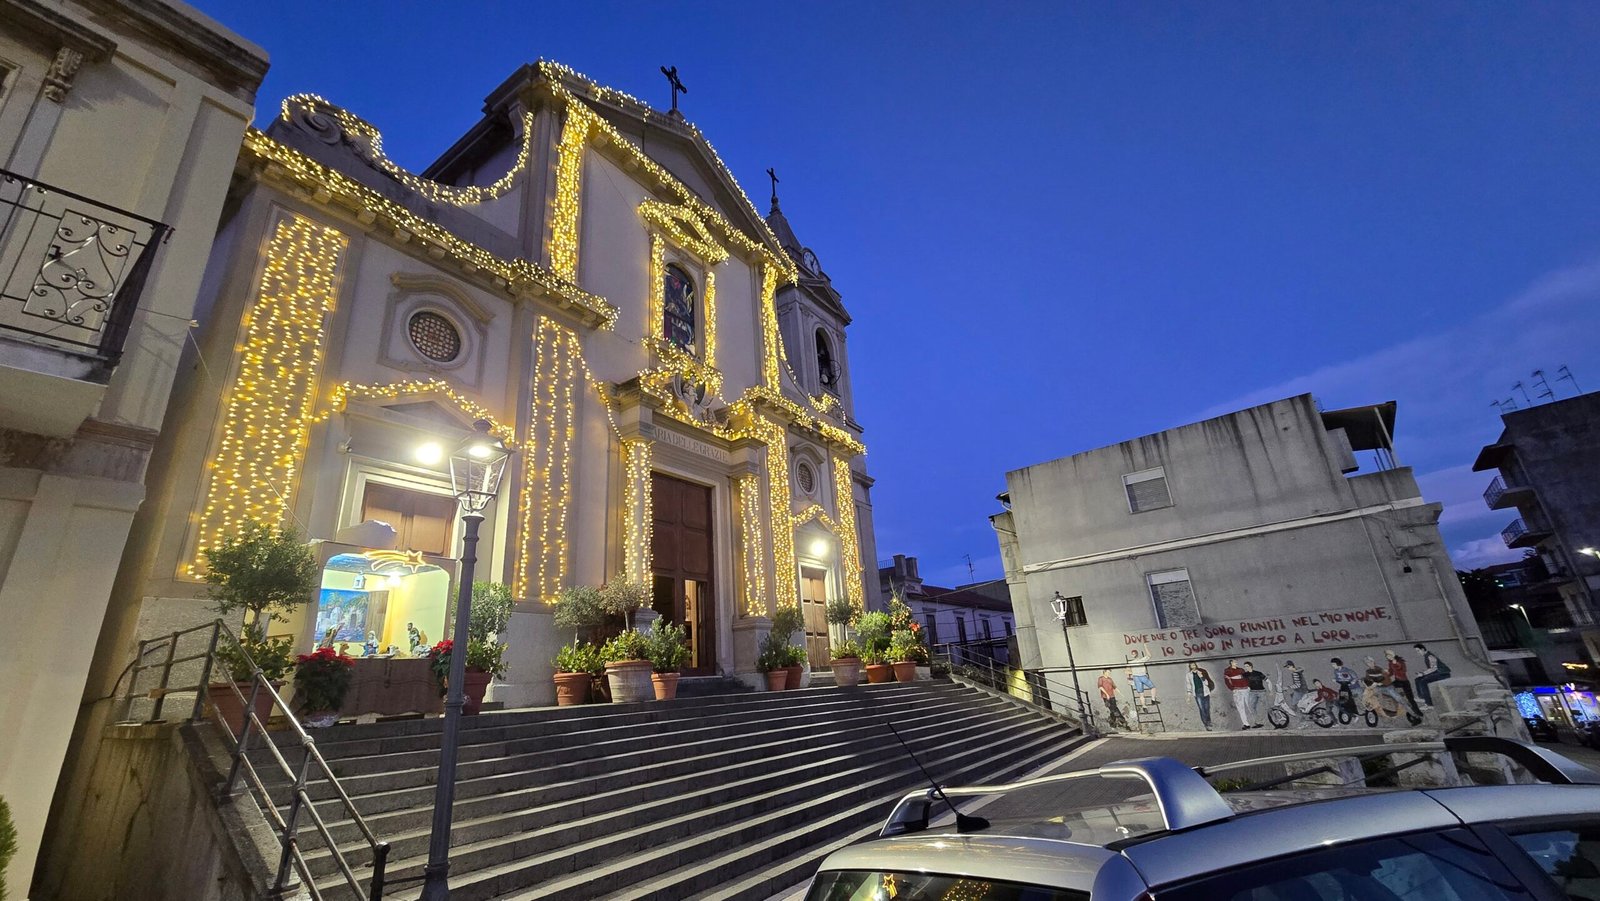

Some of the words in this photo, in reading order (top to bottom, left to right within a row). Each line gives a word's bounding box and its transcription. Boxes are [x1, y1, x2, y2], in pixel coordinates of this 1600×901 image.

[1124, 633, 1150, 645] DOVE
[1151, 633, 1168, 641] DUE
[1170, 631, 1177, 640] O
[1180, 629, 1200, 641] TRE
[1205, 626, 1235, 638] SONO
[1240, 619, 1286, 633] RIUNITI
[1292, 616, 1319, 627] NEL
[1319, 612, 1343, 624] MIO
[1344, 606, 1391, 622] NOME,
[1161, 646, 1175, 657] IO
[1183, 641, 1215, 656] SONO
[1221, 638, 1234, 651] IN
[1241, 634, 1287, 649] MEZZO
[1294, 632, 1305, 644] A
[1312, 629, 1356, 643] LORO.
